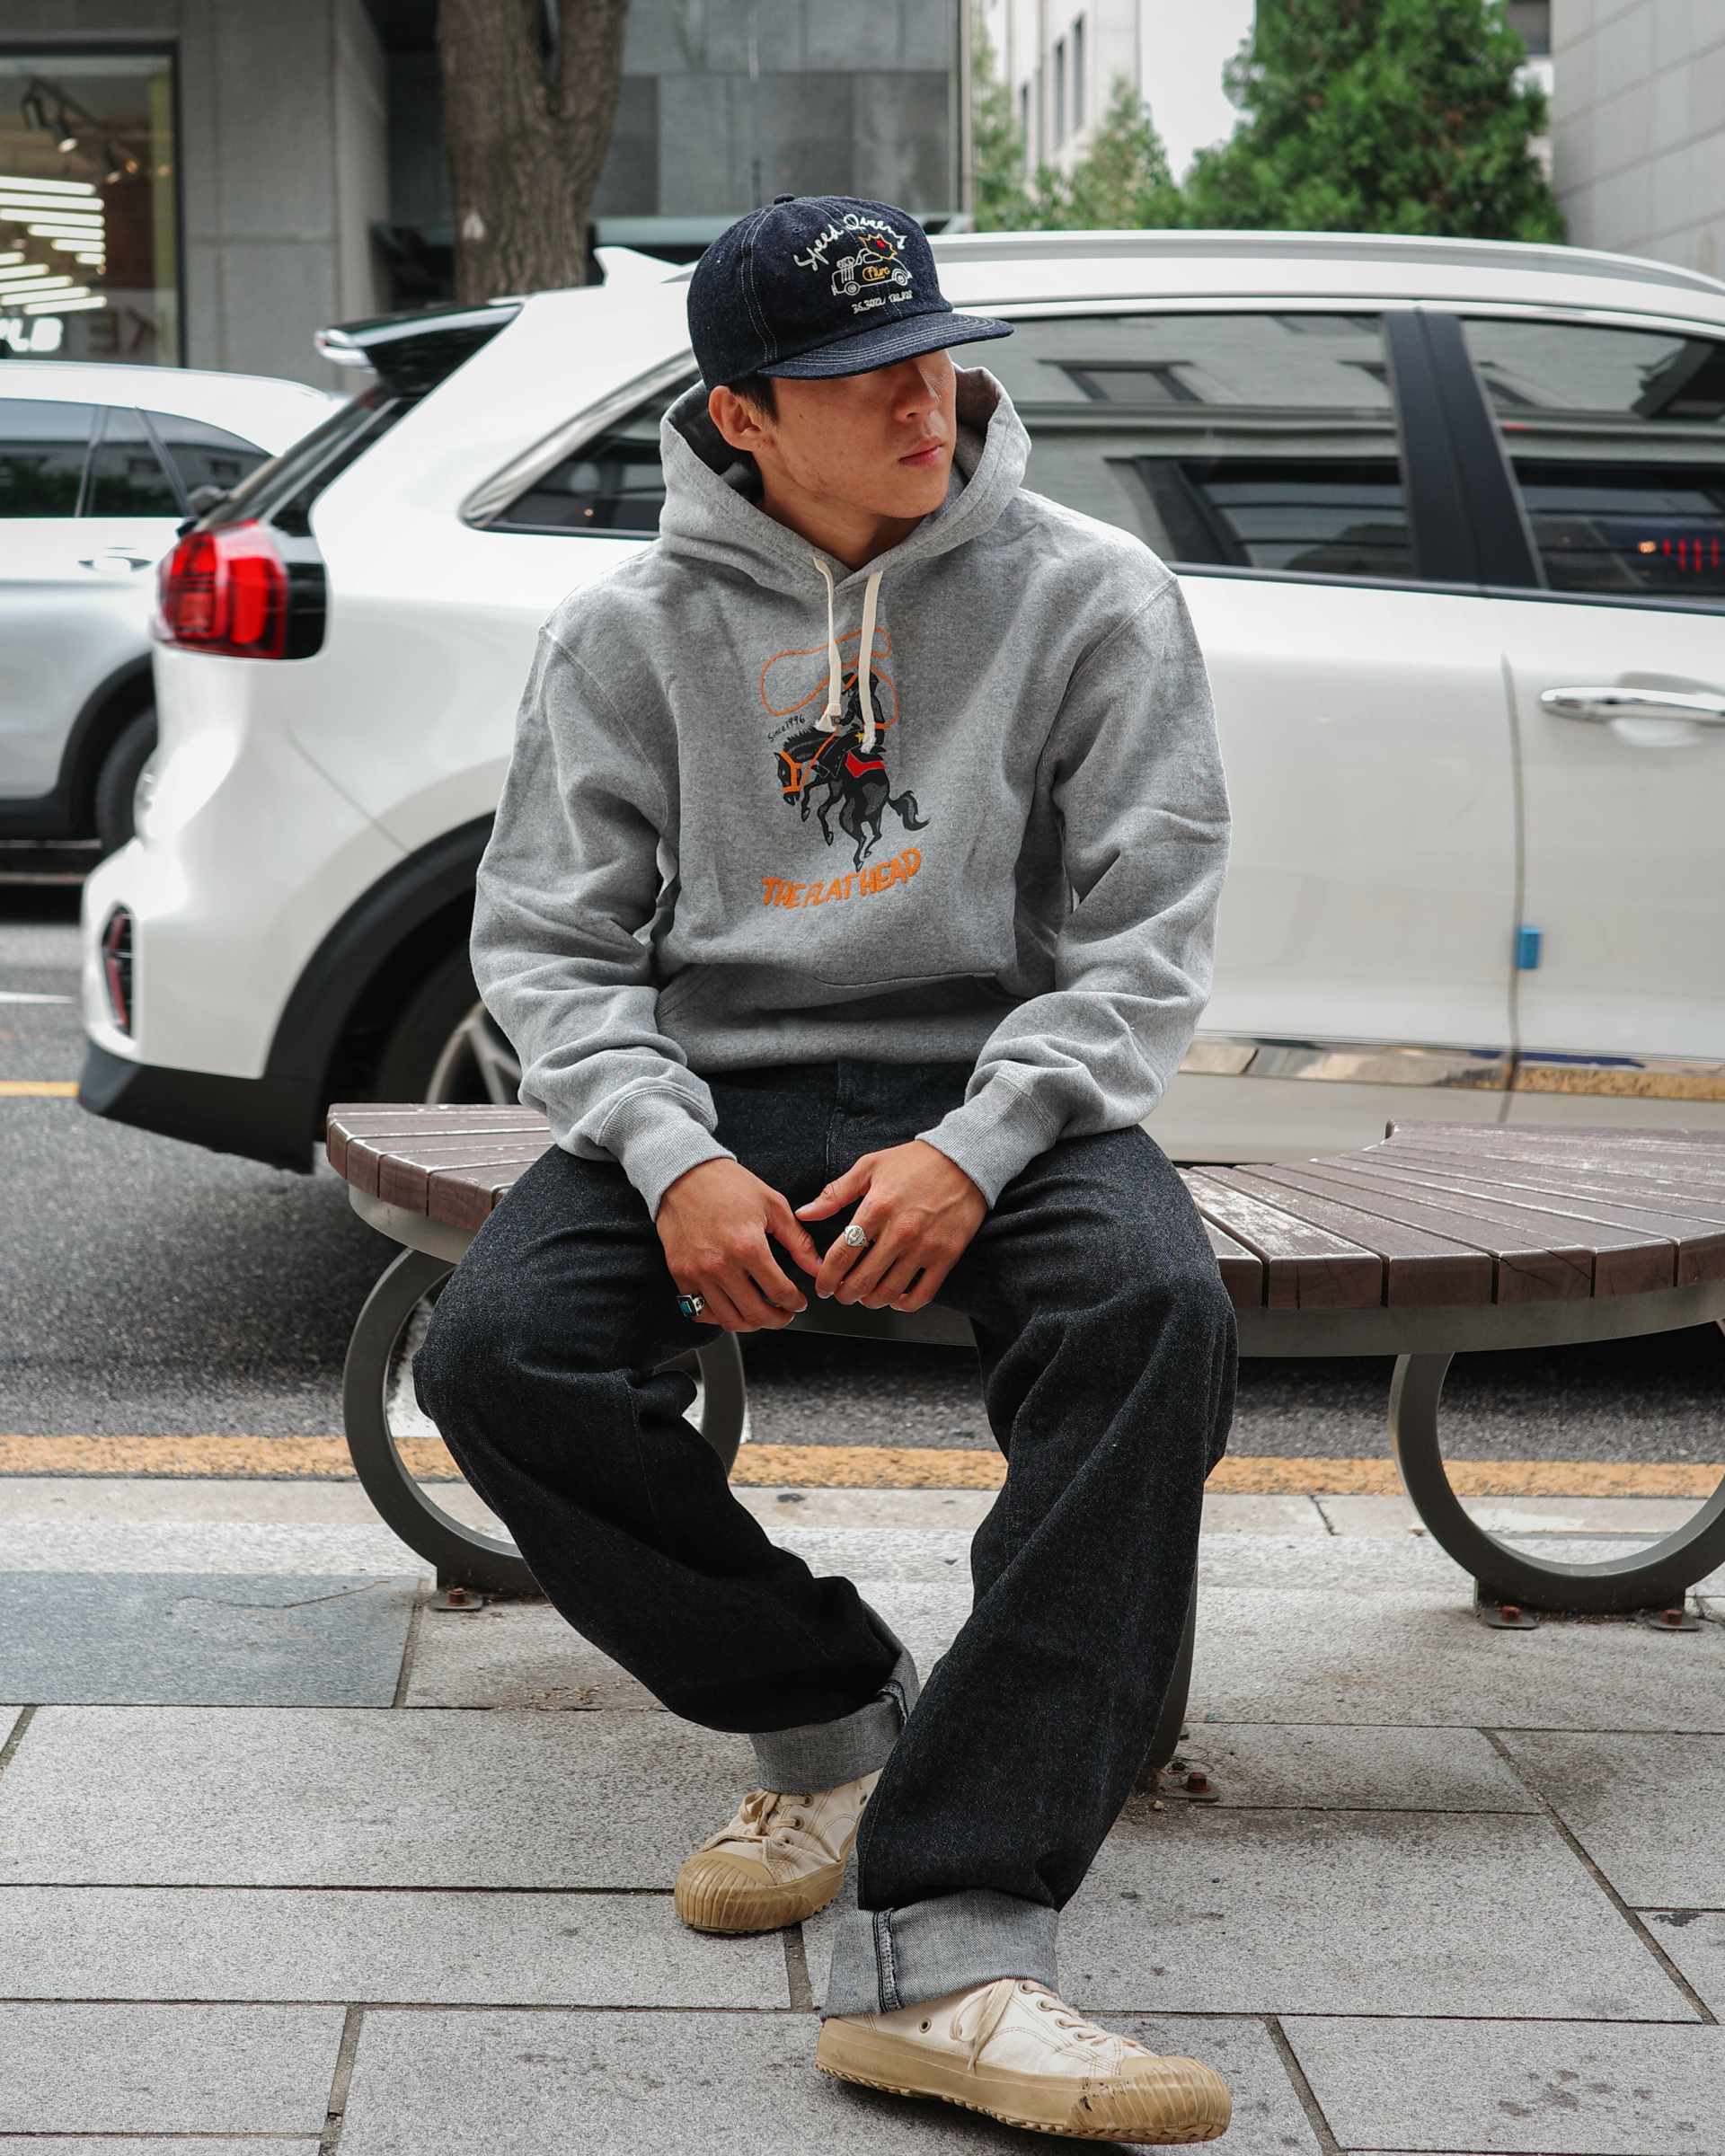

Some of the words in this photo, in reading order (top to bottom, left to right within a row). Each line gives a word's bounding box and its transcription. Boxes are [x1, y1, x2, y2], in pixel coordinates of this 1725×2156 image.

[793, 224, 844, 271] Speed
[761, 878, 806, 909] THE
[859, 847, 922, 897] HEAD
